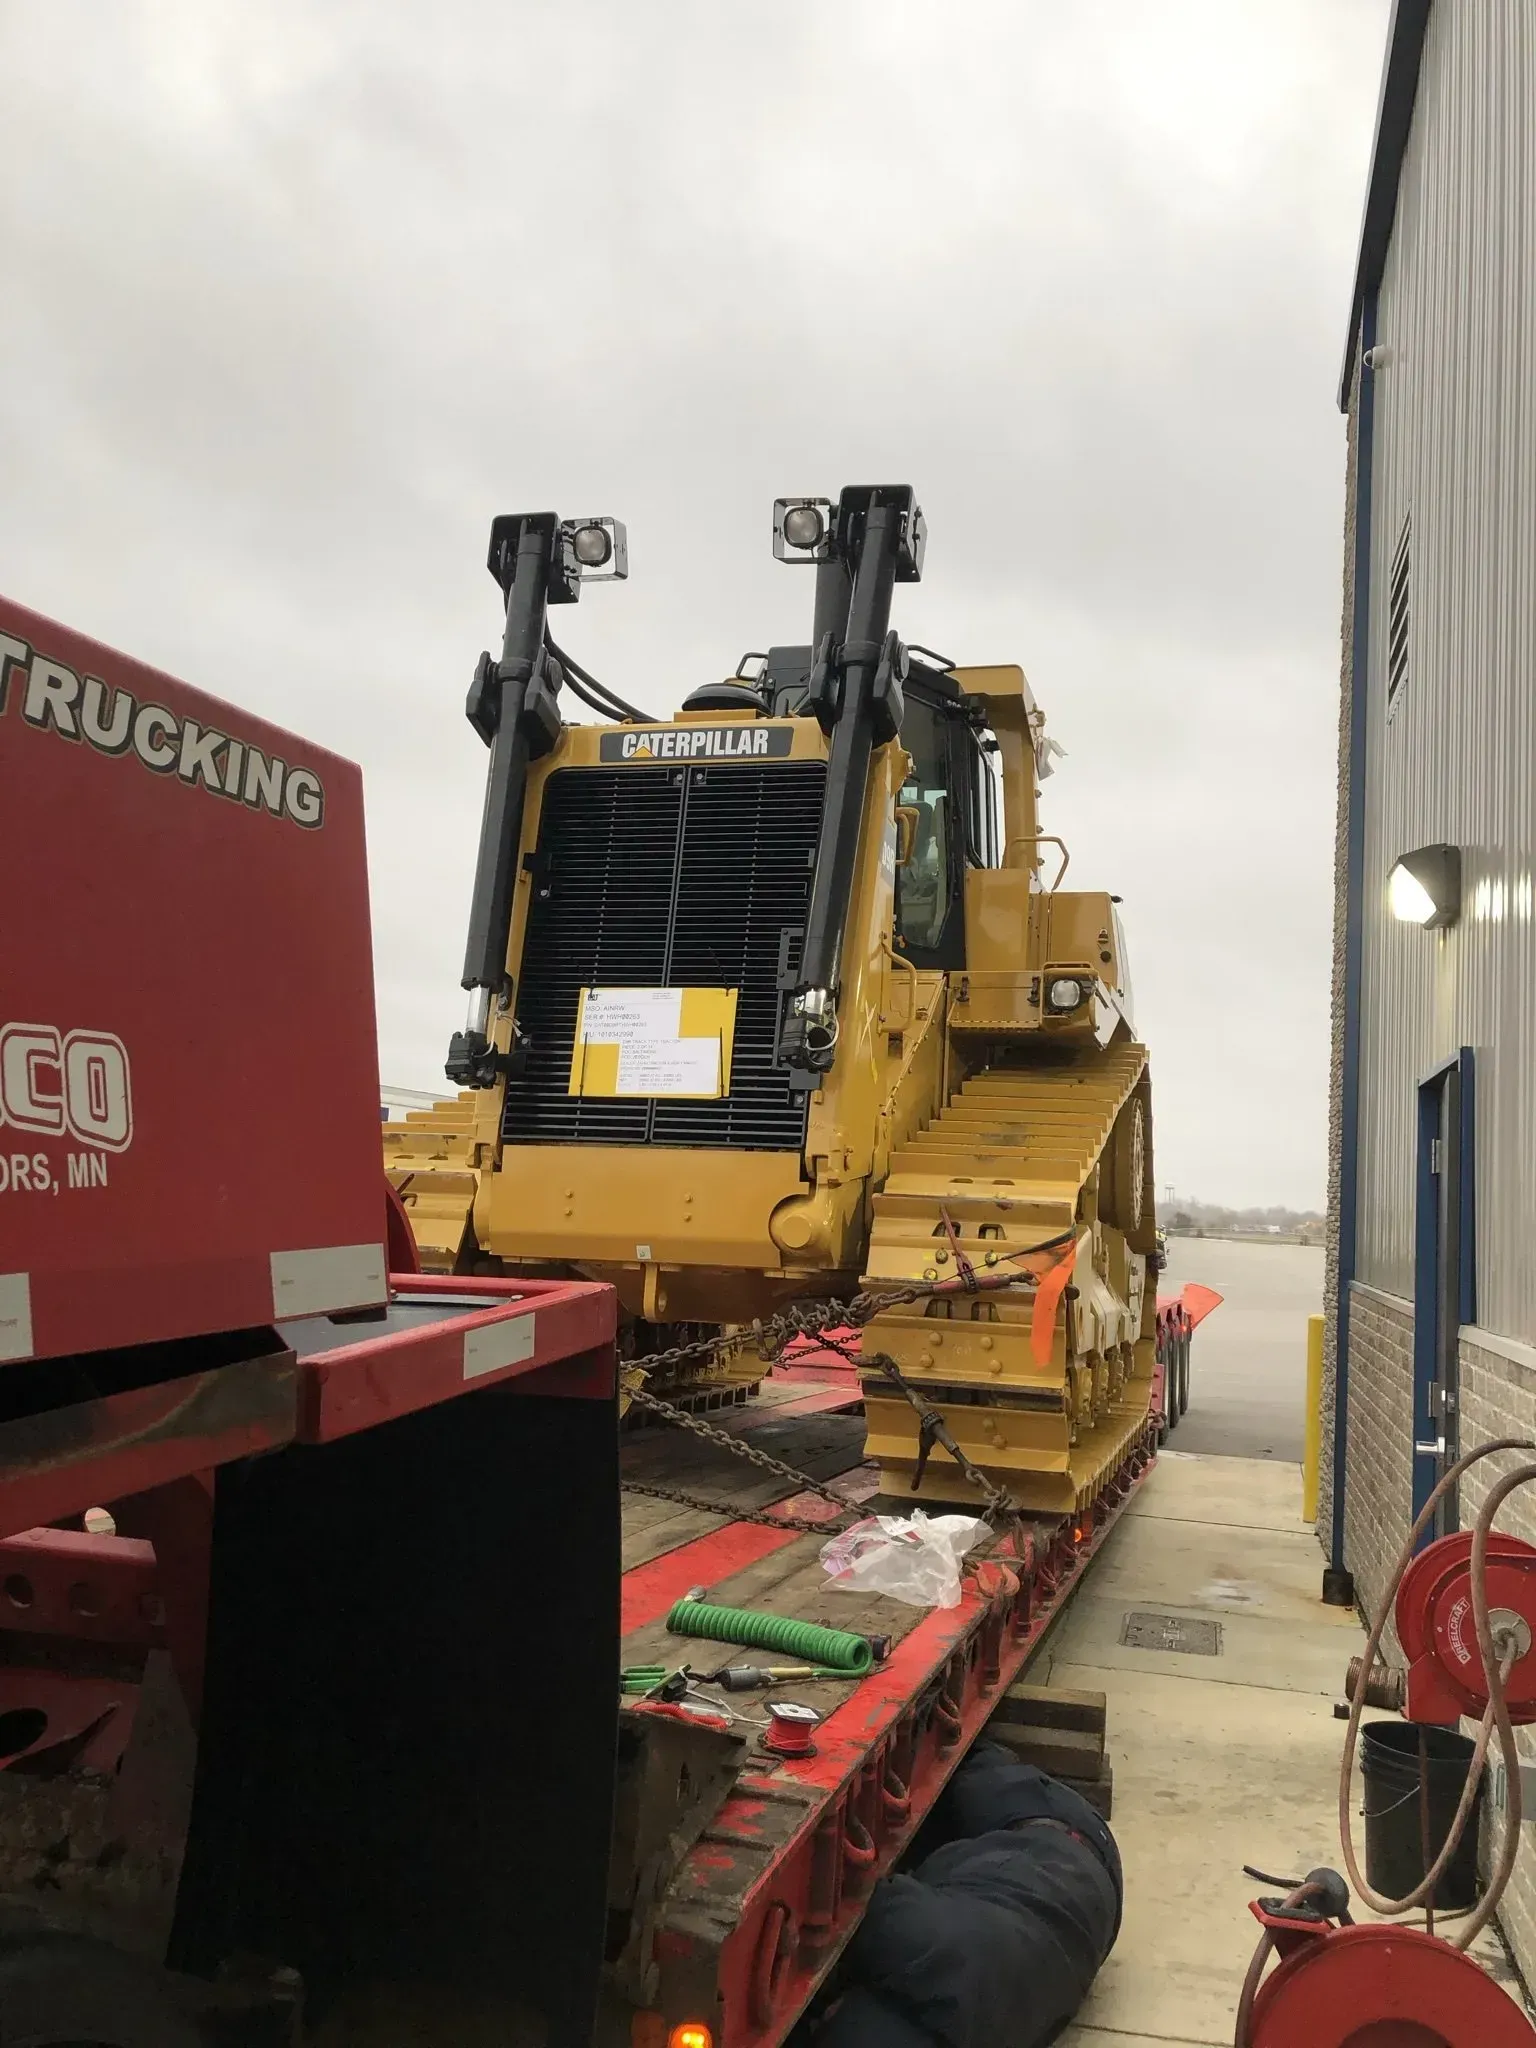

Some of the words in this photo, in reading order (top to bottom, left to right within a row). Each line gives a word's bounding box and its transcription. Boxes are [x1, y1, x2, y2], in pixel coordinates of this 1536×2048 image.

[622, 729, 769, 758] CATERPILLAR
[0, 1022, 132, 1153] CO
[67, 1152, 108, 1189] MN
[1449, 1599, 1469, 1657] REELCRAFT
